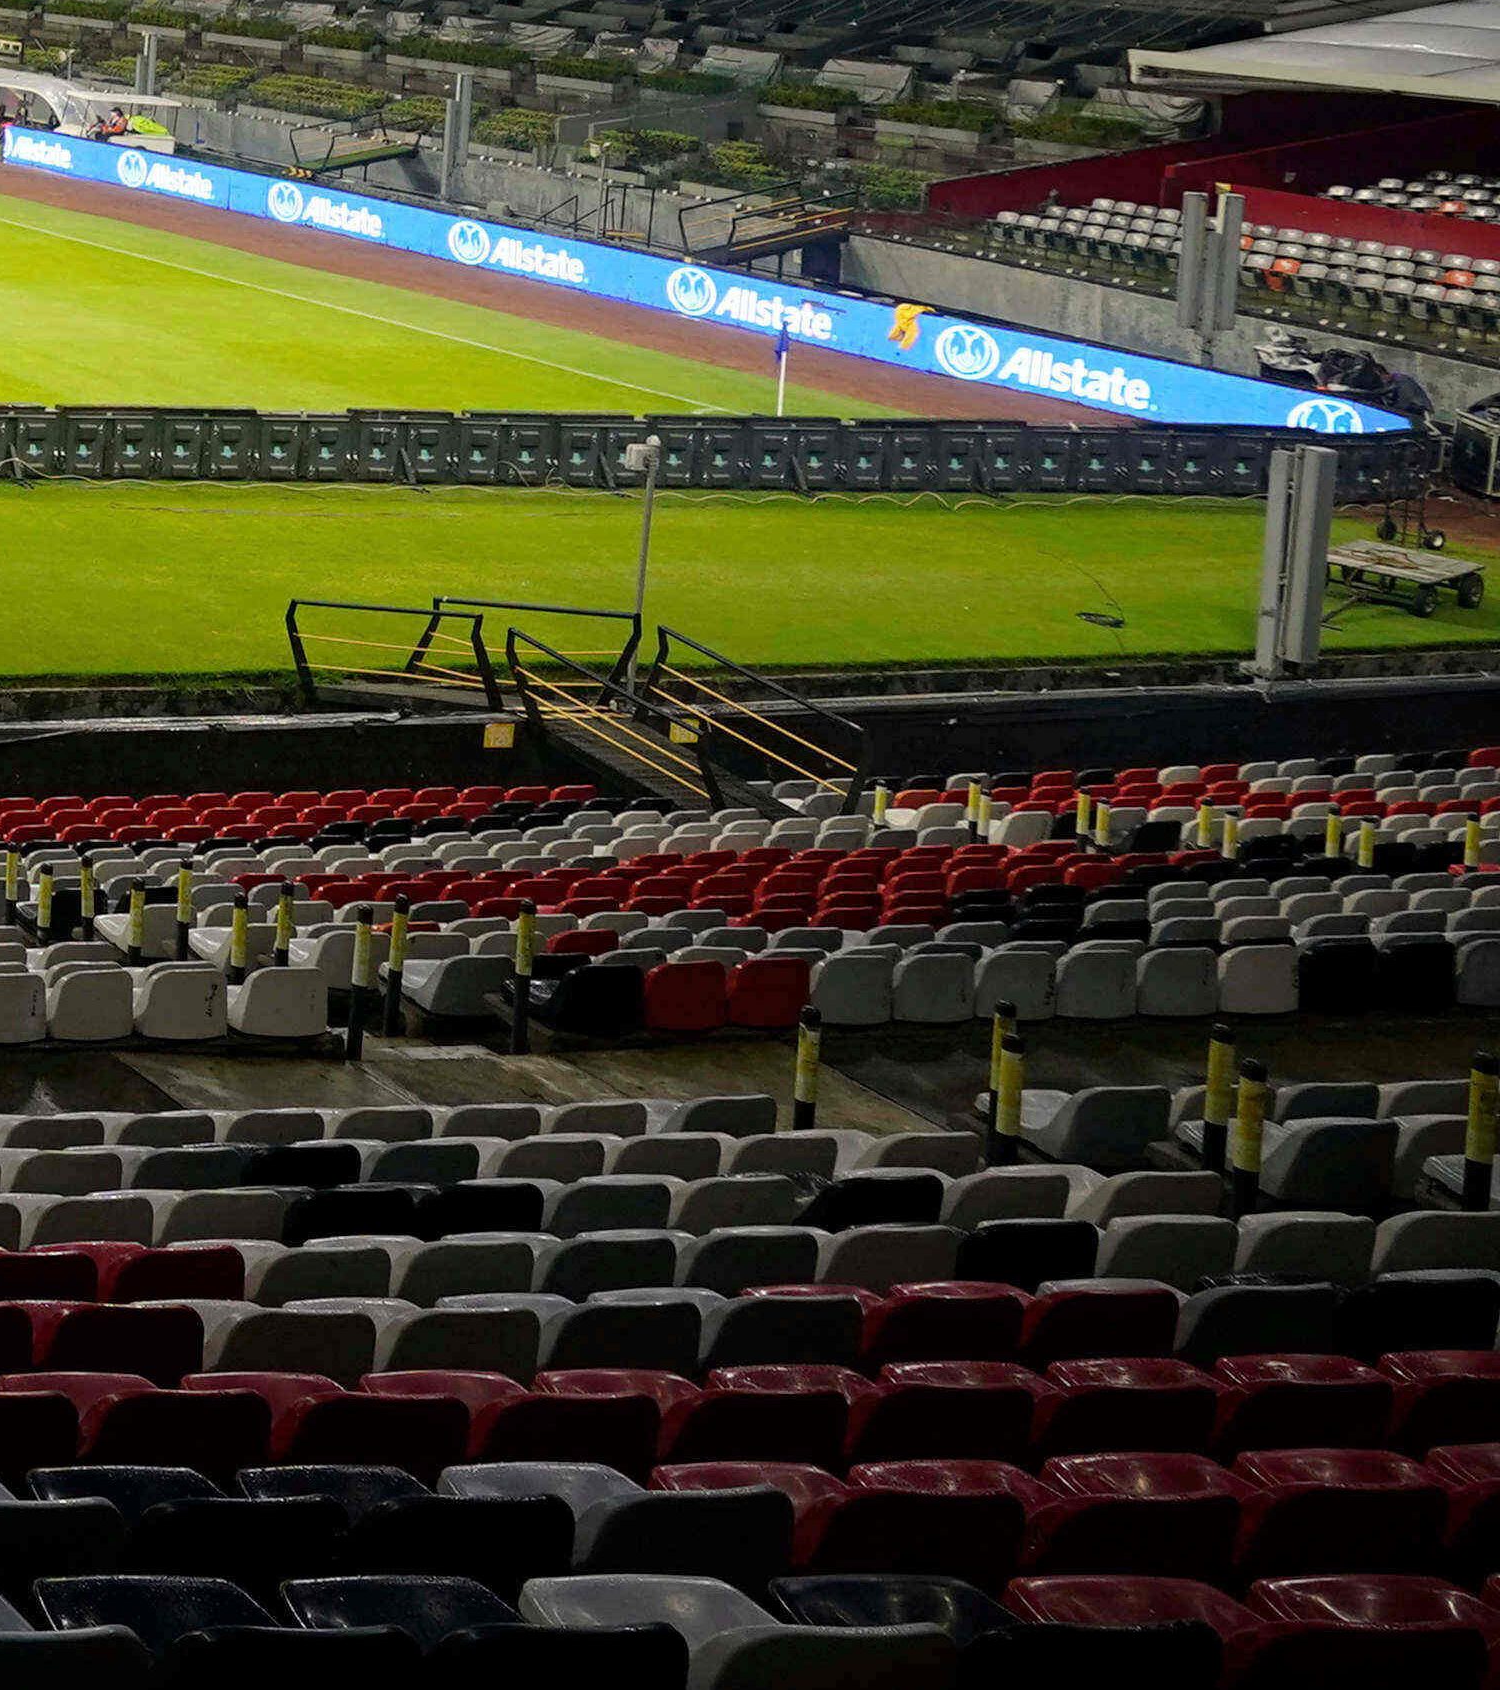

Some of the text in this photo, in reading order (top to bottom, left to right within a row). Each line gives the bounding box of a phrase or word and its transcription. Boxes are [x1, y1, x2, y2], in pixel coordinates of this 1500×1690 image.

[13, 136, 72, 169] Allstate
[145, 162, 213, 200] Allstate
[302, 195, 383, 238] Allstate
[489, 236, 585, 284] Allstate
[714, 286, 833, 341] Allstate
[997, 346, 1152, 411] Allstate
